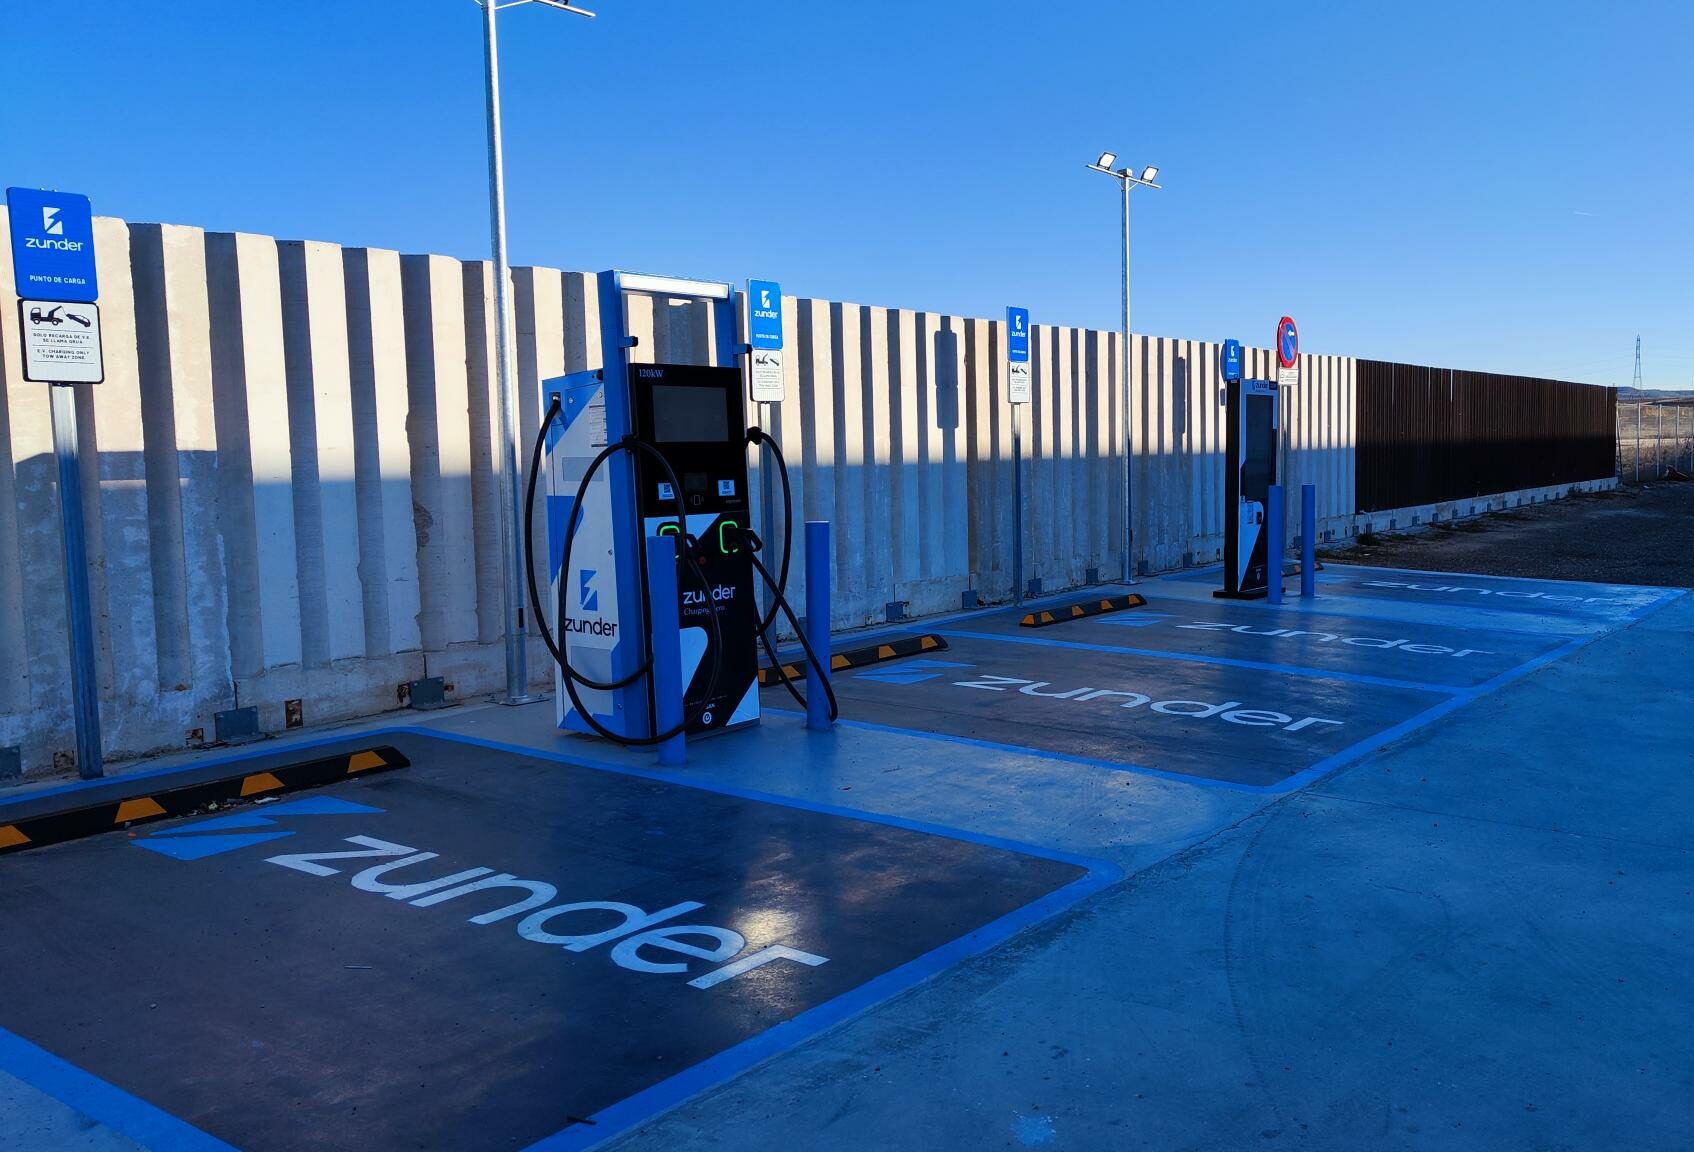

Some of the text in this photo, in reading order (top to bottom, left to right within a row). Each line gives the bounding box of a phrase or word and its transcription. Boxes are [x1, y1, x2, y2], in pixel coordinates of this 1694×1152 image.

[25, 237, 84, 252] zunder
[29, 274, 86, 285] PUNTO DE CARGA
[754, 310, 778, 319] zunder
[639, 368, 664, 378] 120kW
[682, 583, 736, 605] zuder
[1361, 580, 1616, 604] zunder
[564, 616, 618, 638] zunder
[1175, 621, 1495, 658] zunder
[951, 674, 1346, 732] zunder
[263, 834, 831, 990] zunder
